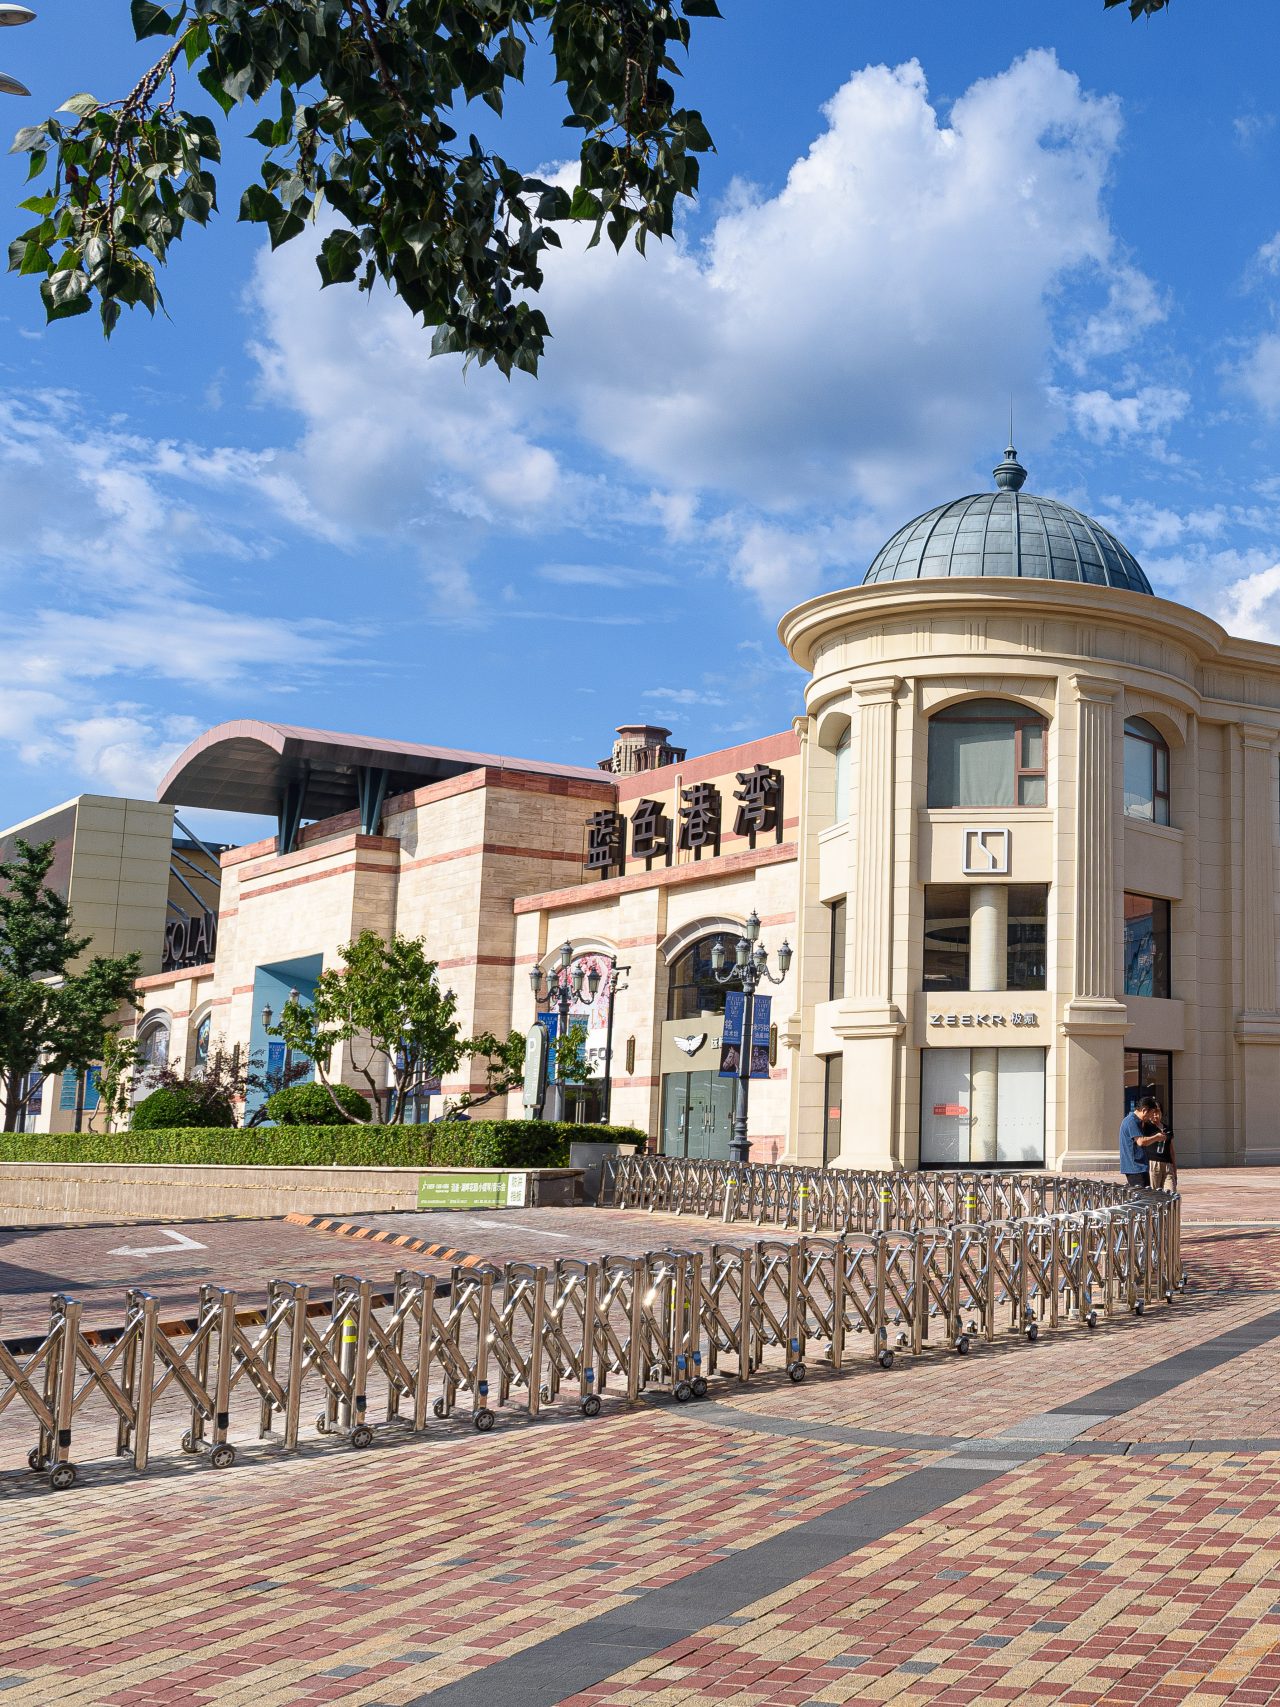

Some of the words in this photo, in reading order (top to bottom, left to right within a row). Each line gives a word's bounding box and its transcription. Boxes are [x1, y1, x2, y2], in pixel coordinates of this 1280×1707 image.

[584, 764, 782, 870] 蓝色港湾
[929, 1014, 1004, 1026] ZEEKR
[1010, 1012, 1038, 1026] 极氪
